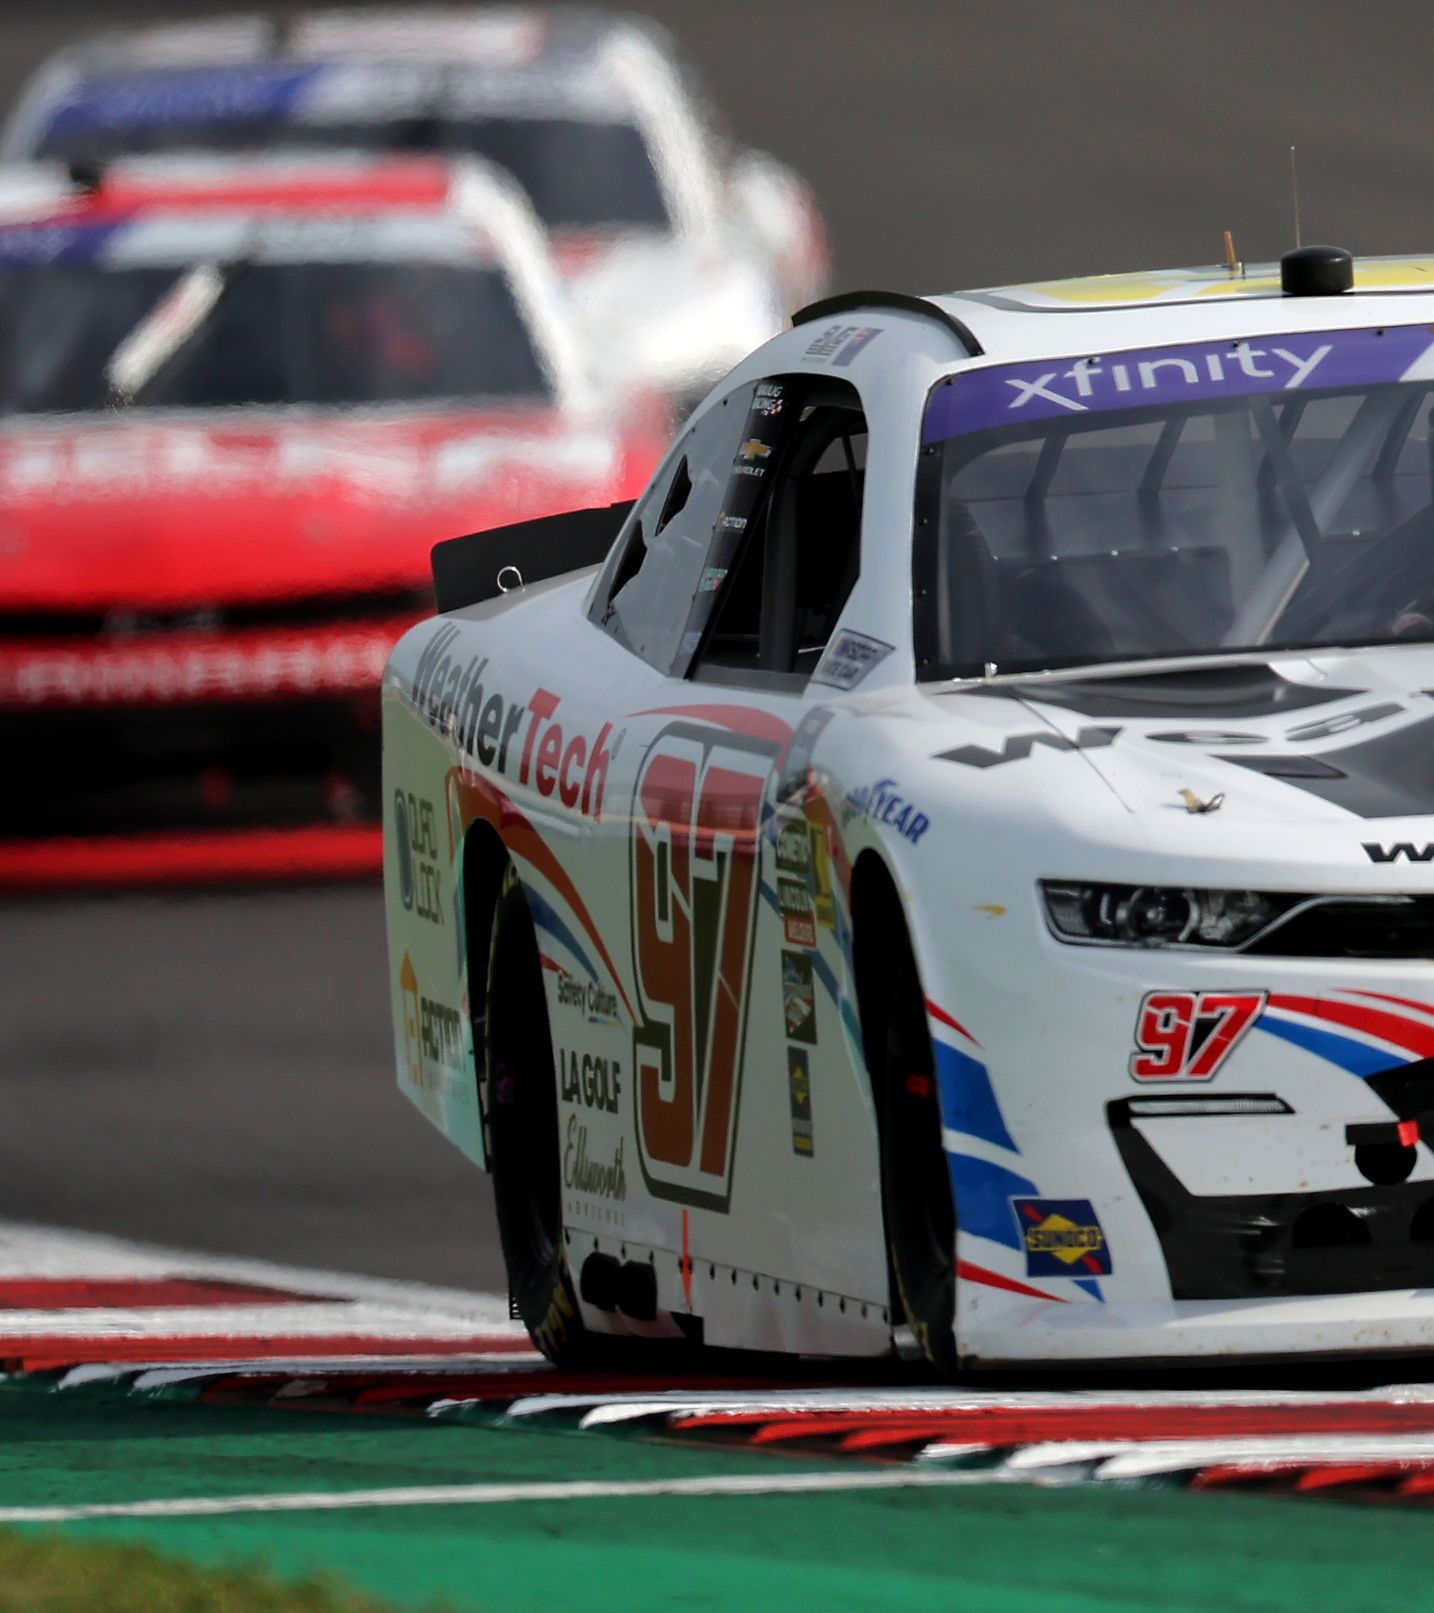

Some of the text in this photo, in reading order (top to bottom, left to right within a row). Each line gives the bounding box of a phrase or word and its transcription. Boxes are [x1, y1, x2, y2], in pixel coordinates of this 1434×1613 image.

[1005, 342, 1333, 412] xfinity
[632, 725, 772, 1205] 97
[1130, 990, 1268, 1083] 97
[1029, 1229, 1099, 1249] SUNOCO
